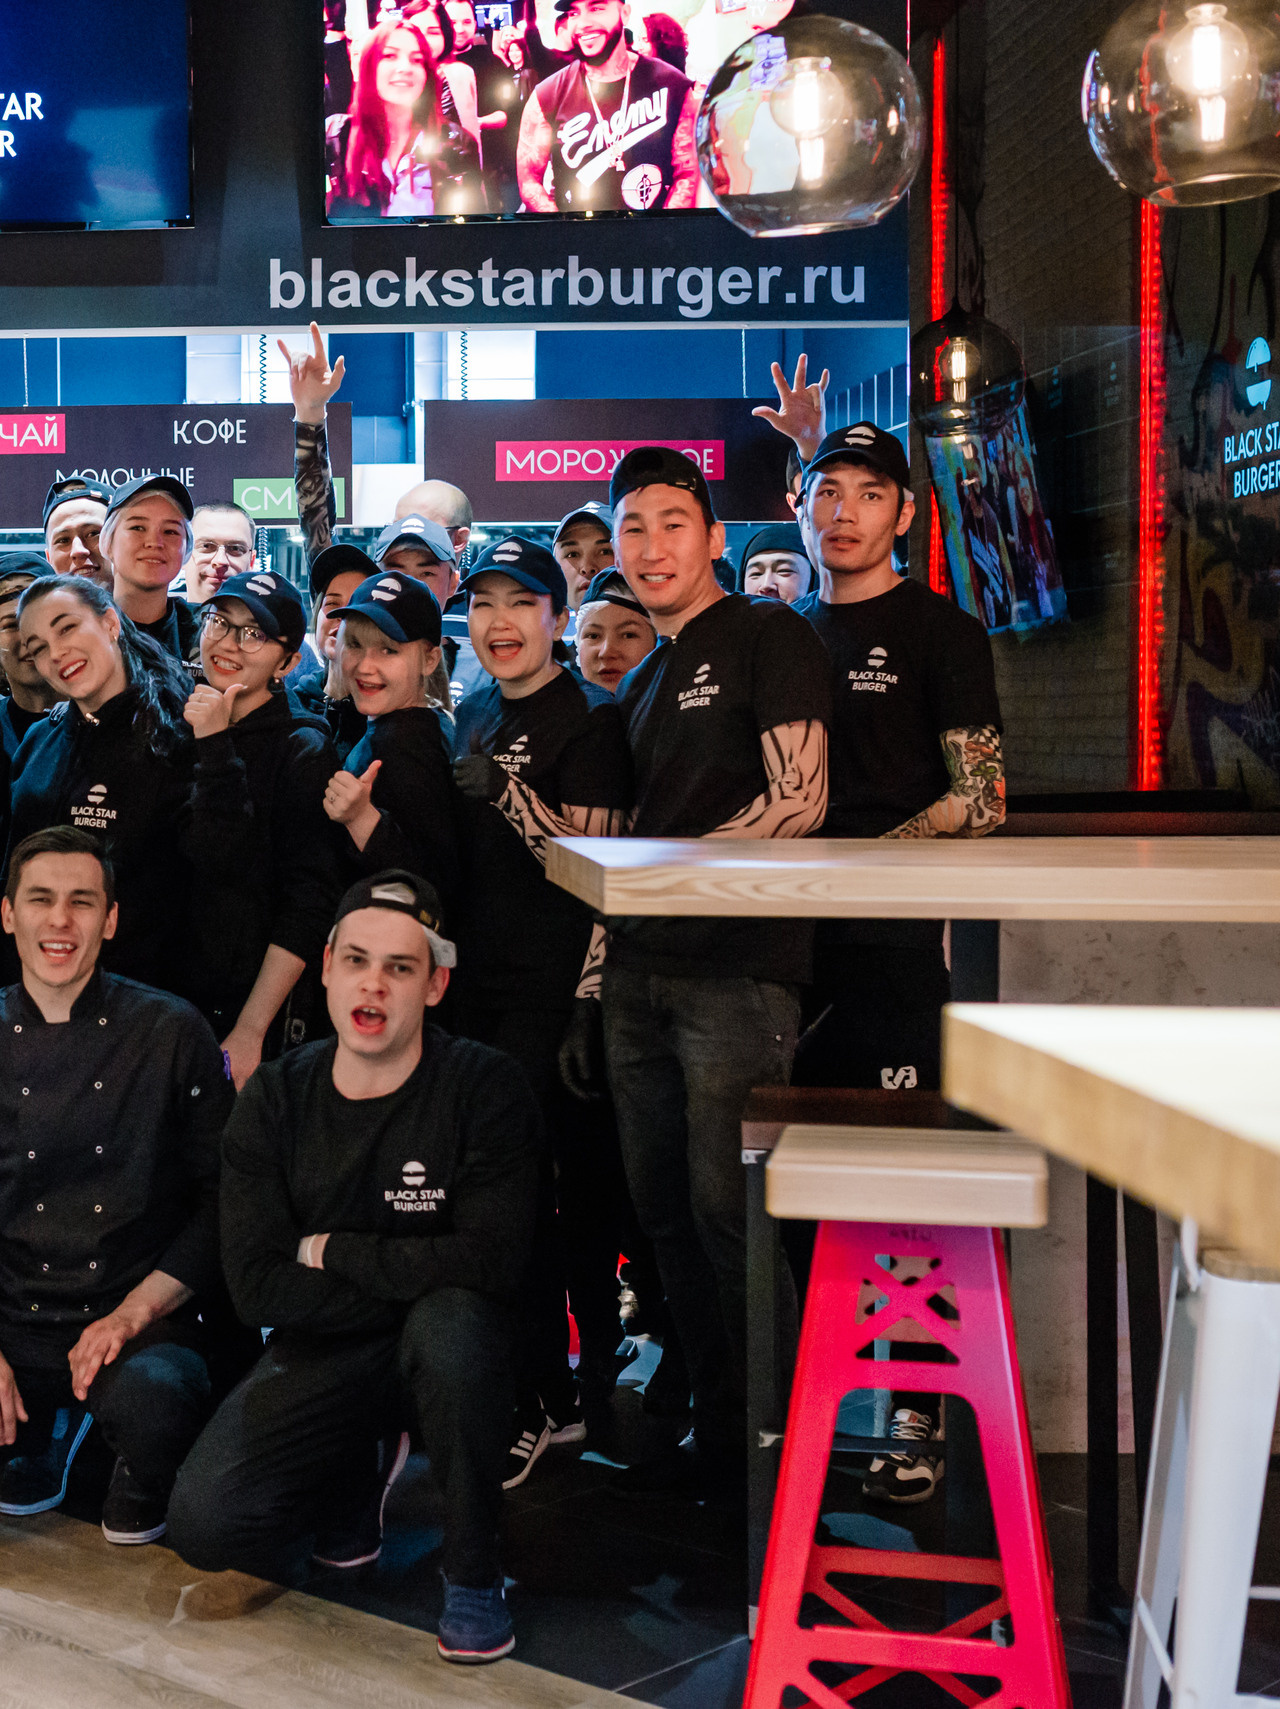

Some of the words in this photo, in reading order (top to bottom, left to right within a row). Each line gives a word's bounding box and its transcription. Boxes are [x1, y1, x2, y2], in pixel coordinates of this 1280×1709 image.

[269, 254, 866, 319] blackstarburger.ru
[173, 417, 247, 445] КОФЕ
[1224, 427, 1263, 464] BLACK
[1265, 421, 1280, 453] ST
[1234, 460, 1280, 499] BURGER
[848, 670, 875, 680] BLACK
[875, 672, 898, 684] STAR
[678, 687, 699, 701] BLACK
[699, 685, 720, 695] STAR
[852, 681, 887, 693] BURGER
[680, 696, 710, 710] BURGER
[71, 806, 95, 816] BLACK
[95, 808, 117, 819] STAR
[74, 816, 107, 828] BURGER
[384, 1189, 418, 1202] BLACK
[420, 1188, 446, 1200] STAR
[393, 1201, 437, 1212] BURGER
